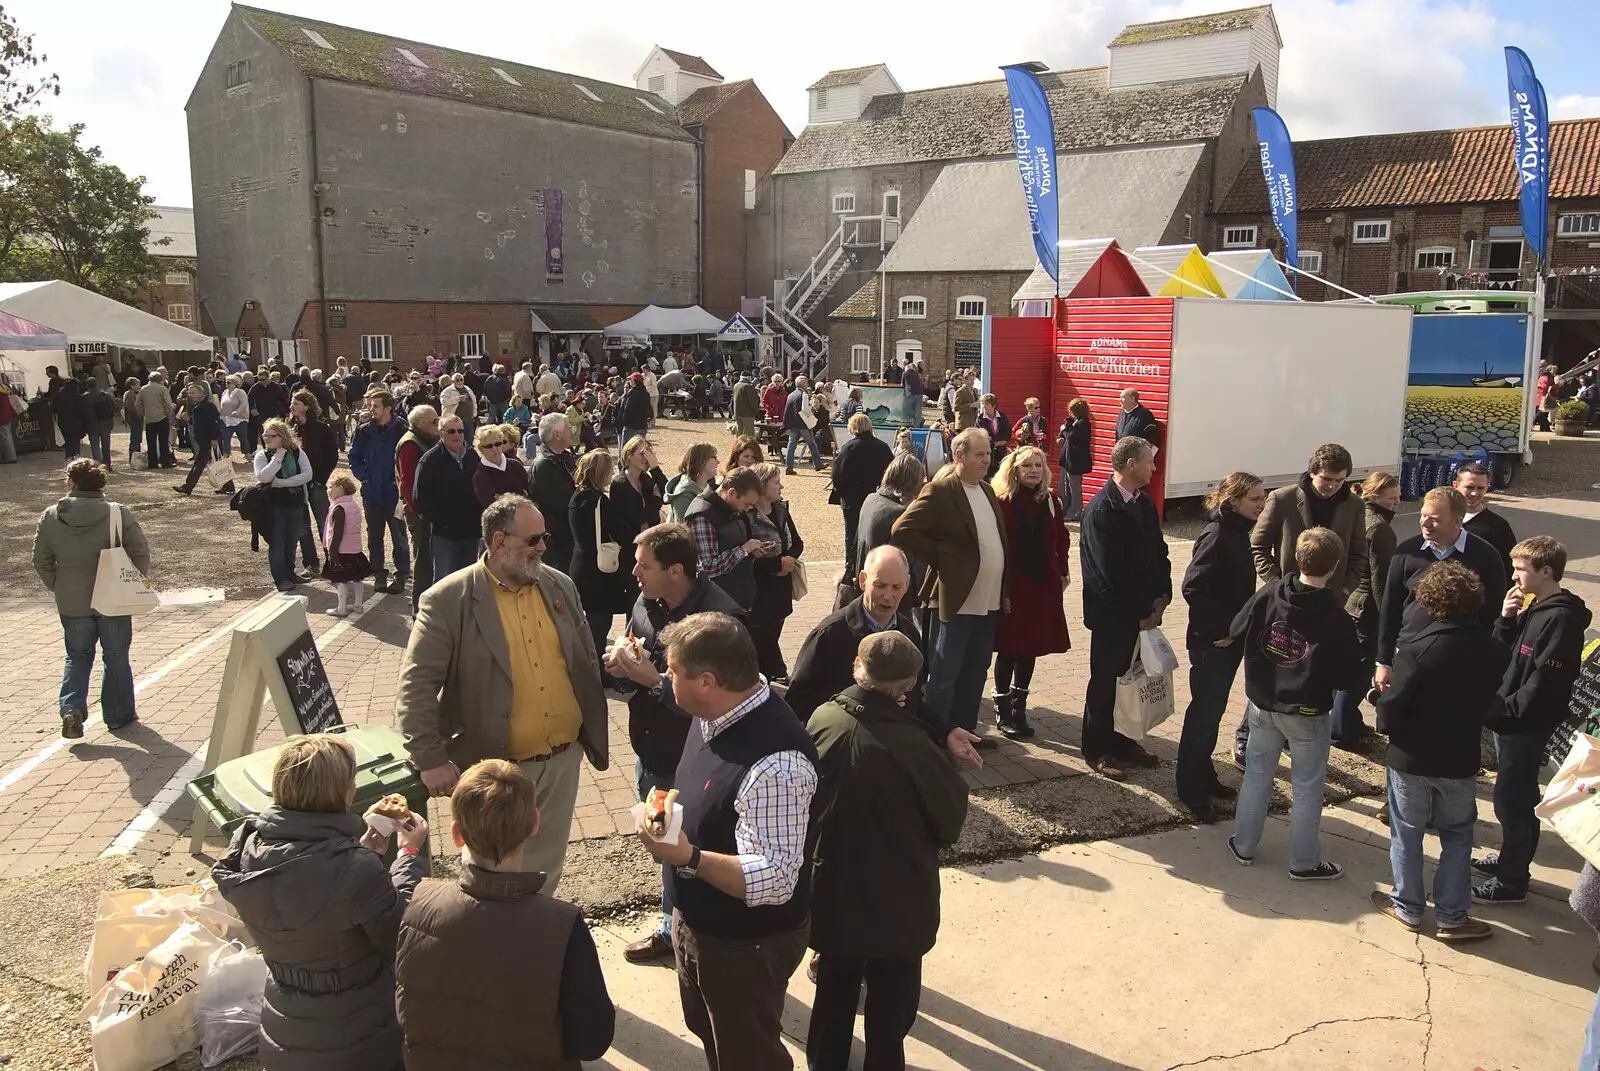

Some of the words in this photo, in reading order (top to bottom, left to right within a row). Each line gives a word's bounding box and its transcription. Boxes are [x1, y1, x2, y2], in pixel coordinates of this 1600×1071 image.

[78, 342, 106, 353] STAGE
[170, 960, 200, 985] DRINK
[139, 978, 199, 1021] festival
